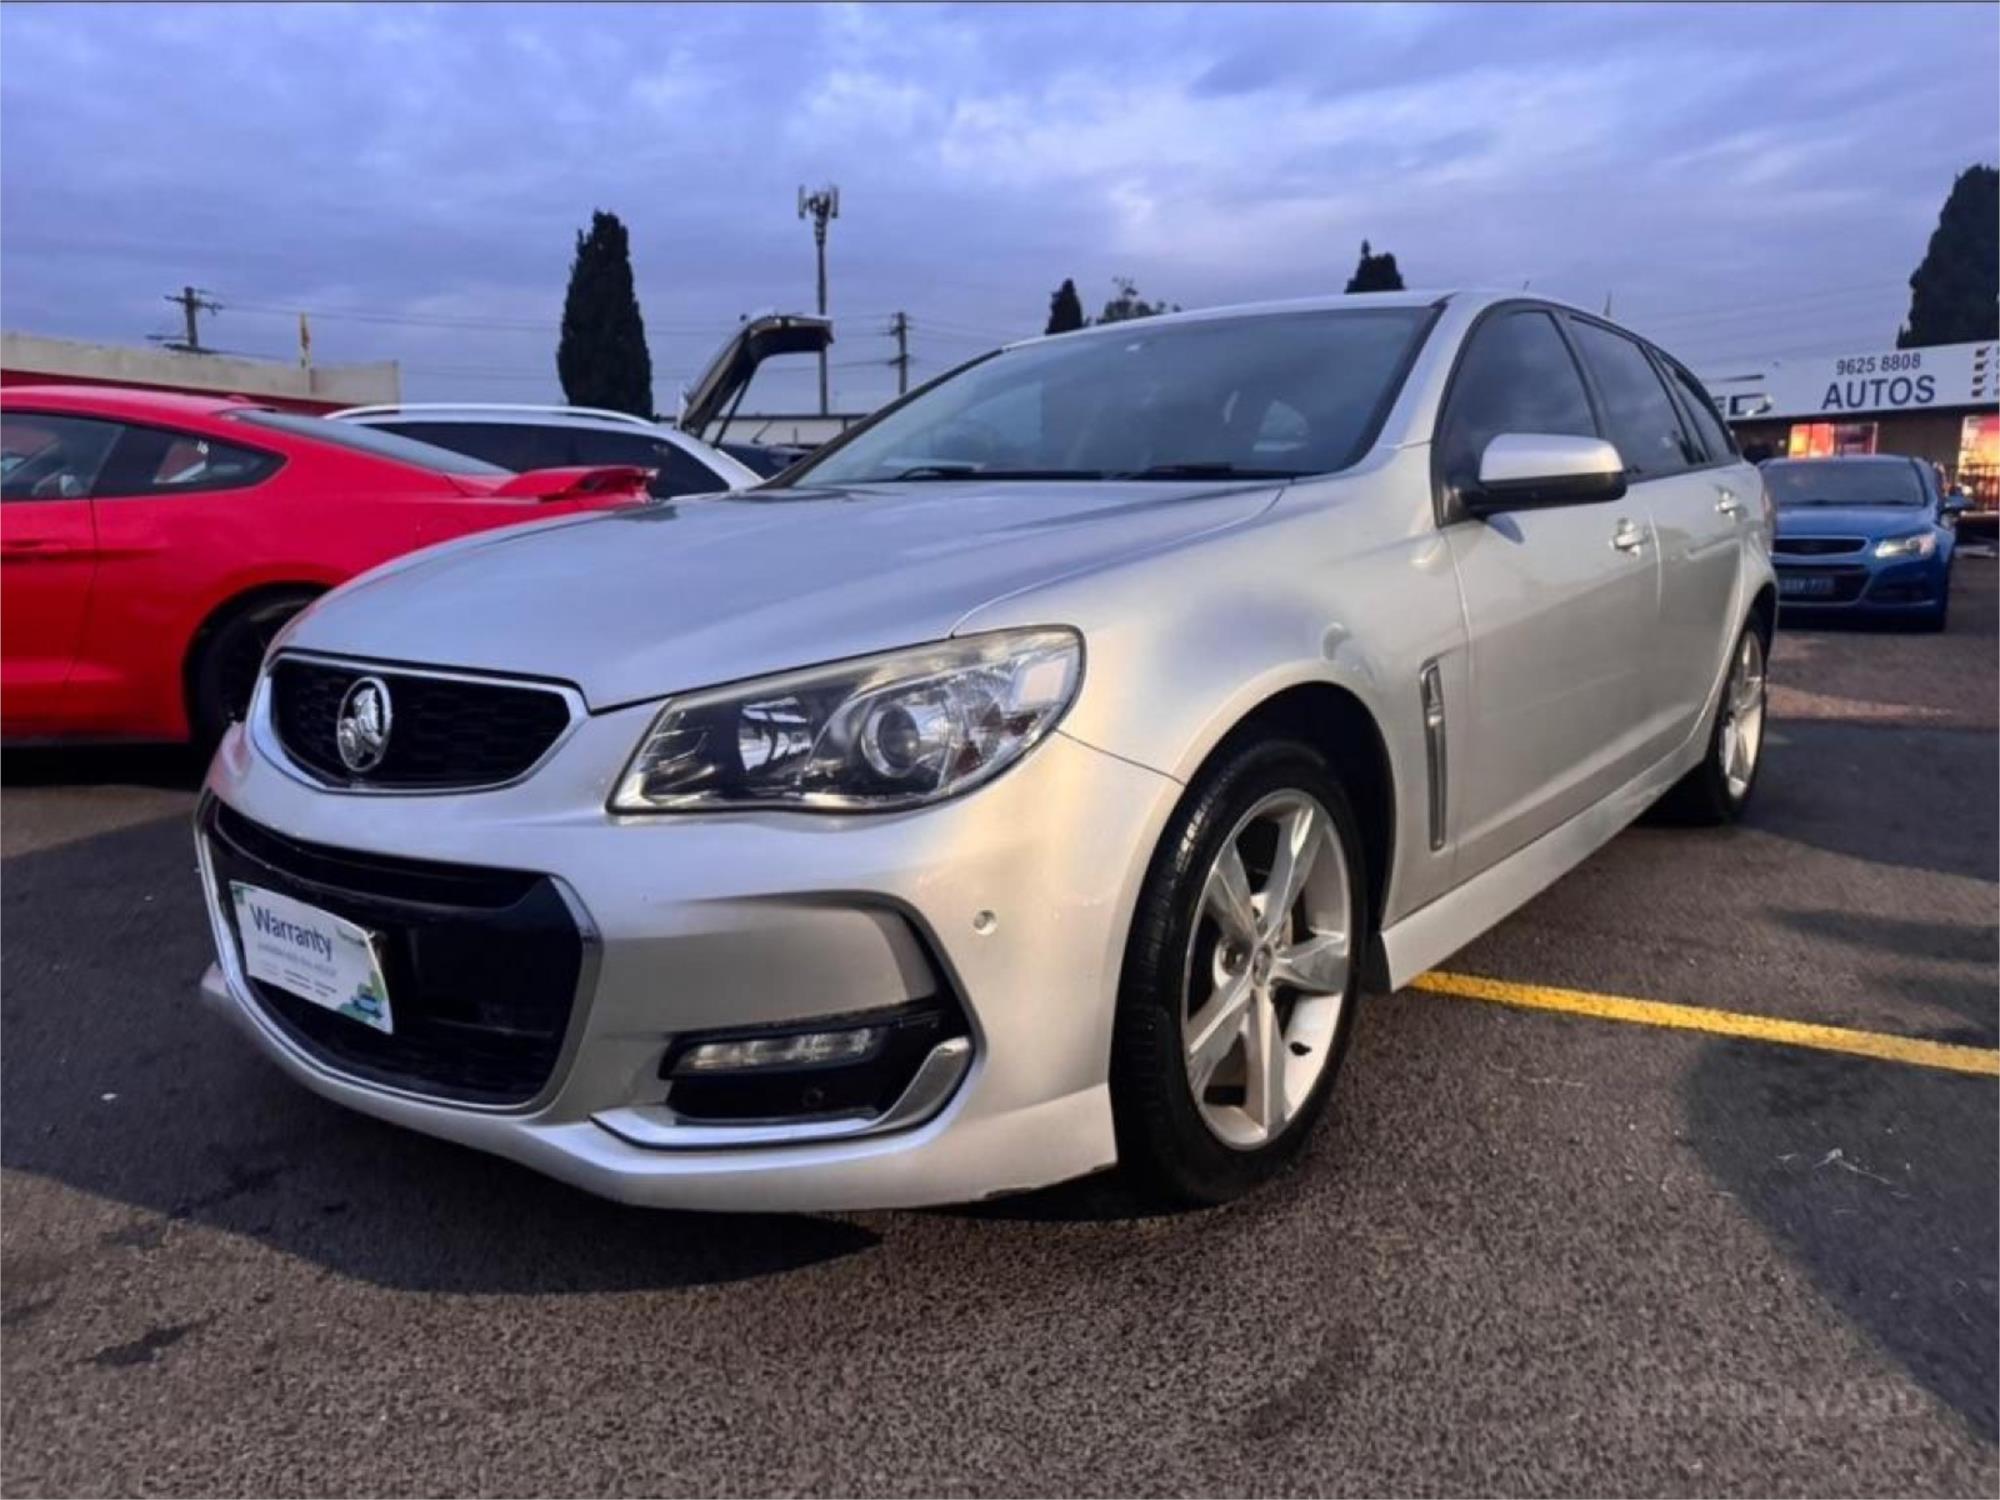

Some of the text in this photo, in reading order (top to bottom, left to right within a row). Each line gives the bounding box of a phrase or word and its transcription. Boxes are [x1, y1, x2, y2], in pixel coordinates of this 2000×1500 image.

[1836, 353, 1921, 375] 9625 8808
[1821, 375, 1935, 410] AUTOS
[249, 903, 332, 961] Warranty
